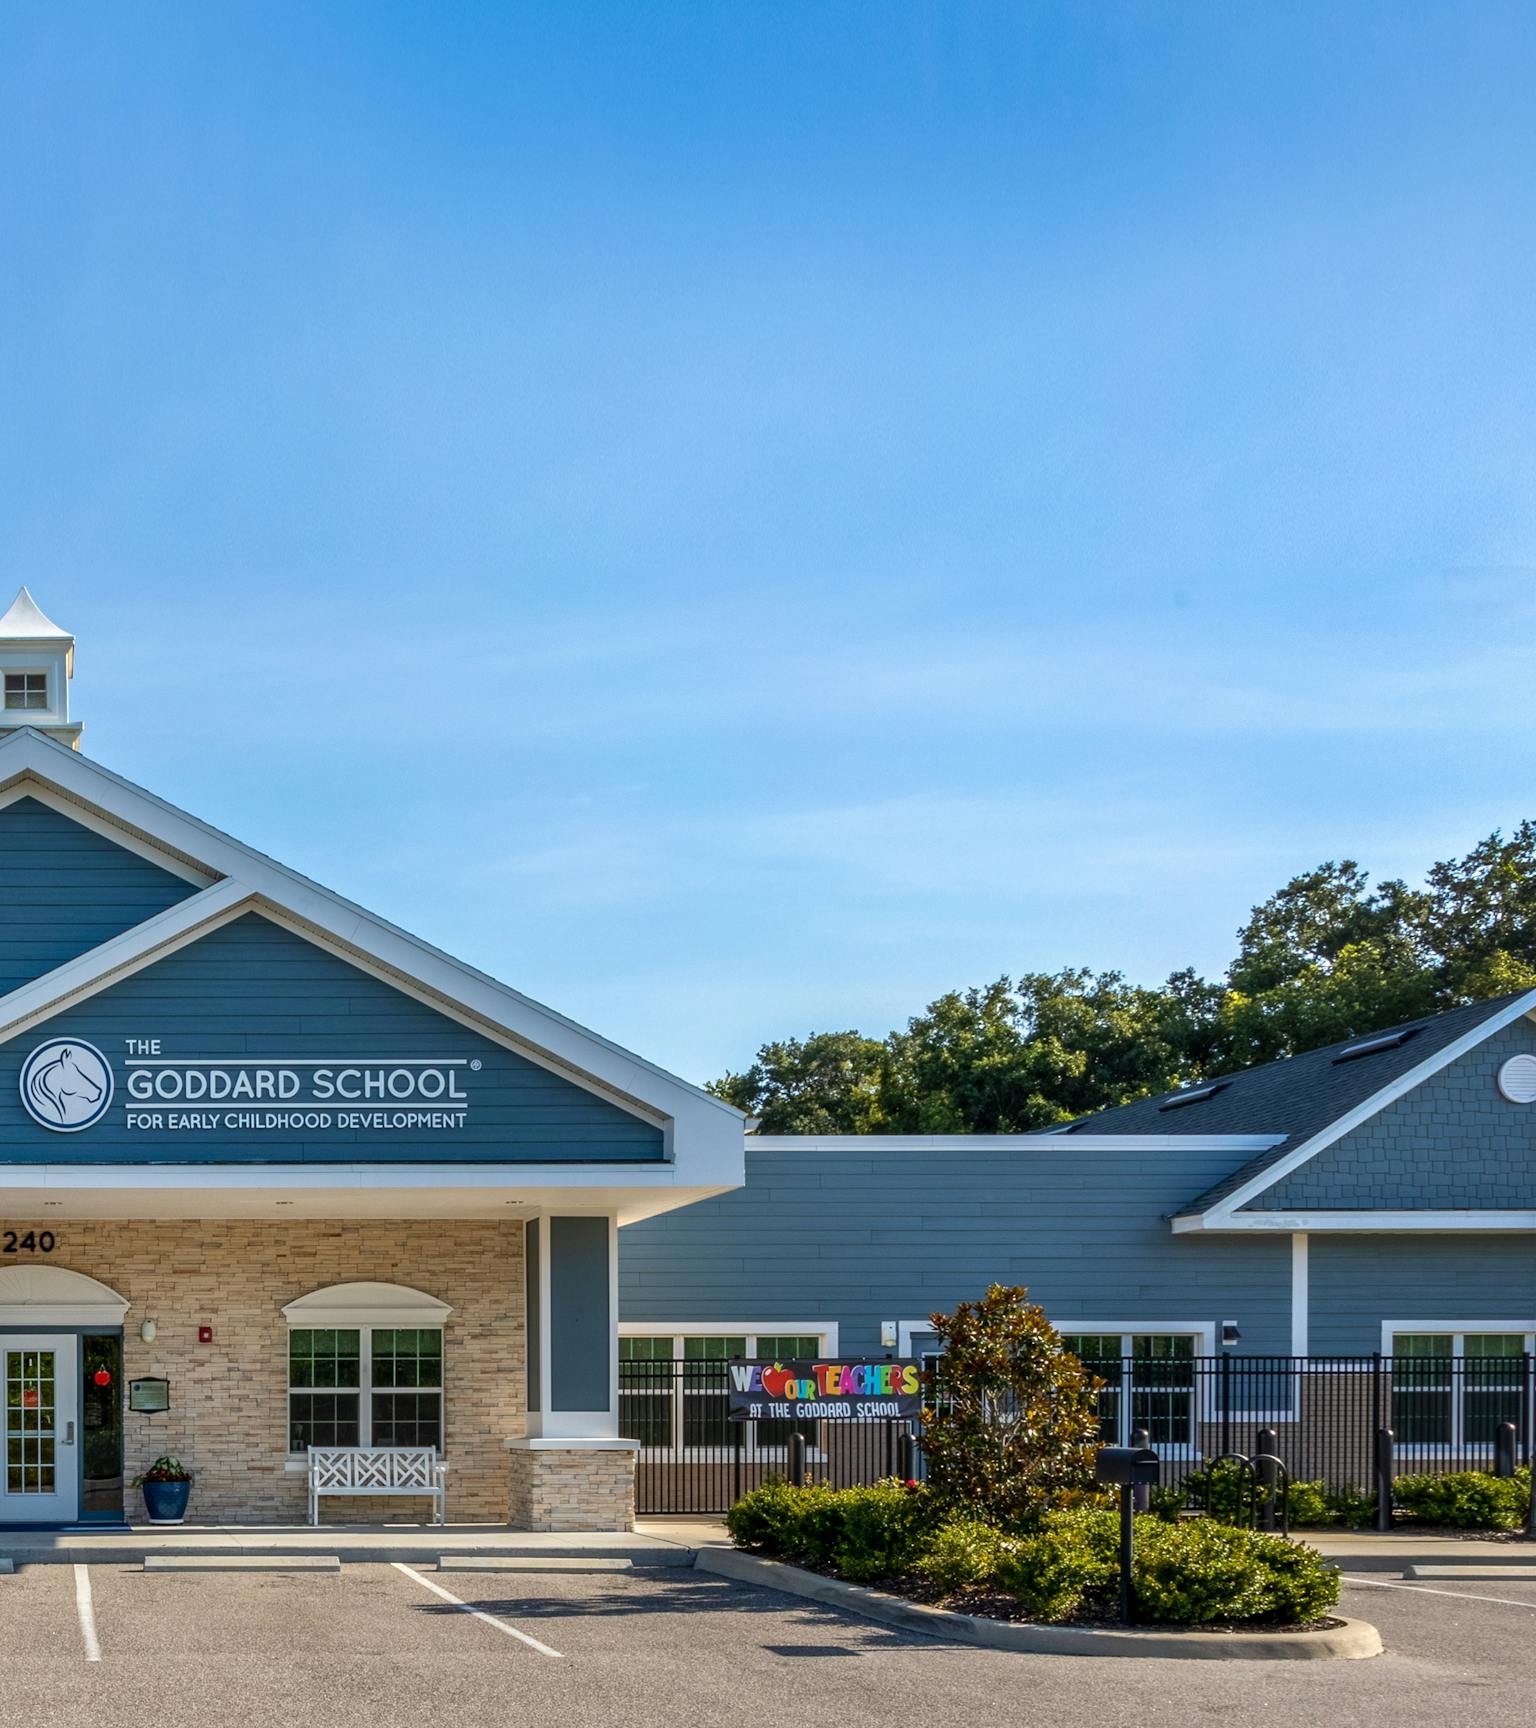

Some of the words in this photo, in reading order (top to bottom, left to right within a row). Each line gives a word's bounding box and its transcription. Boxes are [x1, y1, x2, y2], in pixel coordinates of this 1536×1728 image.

[125, 1039, 161, 1055] THE
[127, 1069, 300, 1099] GODDARD
[312, 1068, 467, 1099] SCHOOL
[126, 1113, 163, 1130] FOR
[168, 1113, 220, 1129] EARLY
[224, 1112, 331, 1129] CHILDHOOD
[338, 1112, 467, 1129] DEVELOPMENT
[3, 1231, 55, 1252] 240
[730, 1364, 763, 1392] WE
[785, 1379, 816, 1400] OUR
[812, 1364, 920, 1397] TEACHERS
[749, 1403, 763, 1418] AT
[768, 1402, 791, 1418] THE
[796, 1402, 851, 1418] GODDARD
[857, 1402, 901, 1418] SCHOOL
